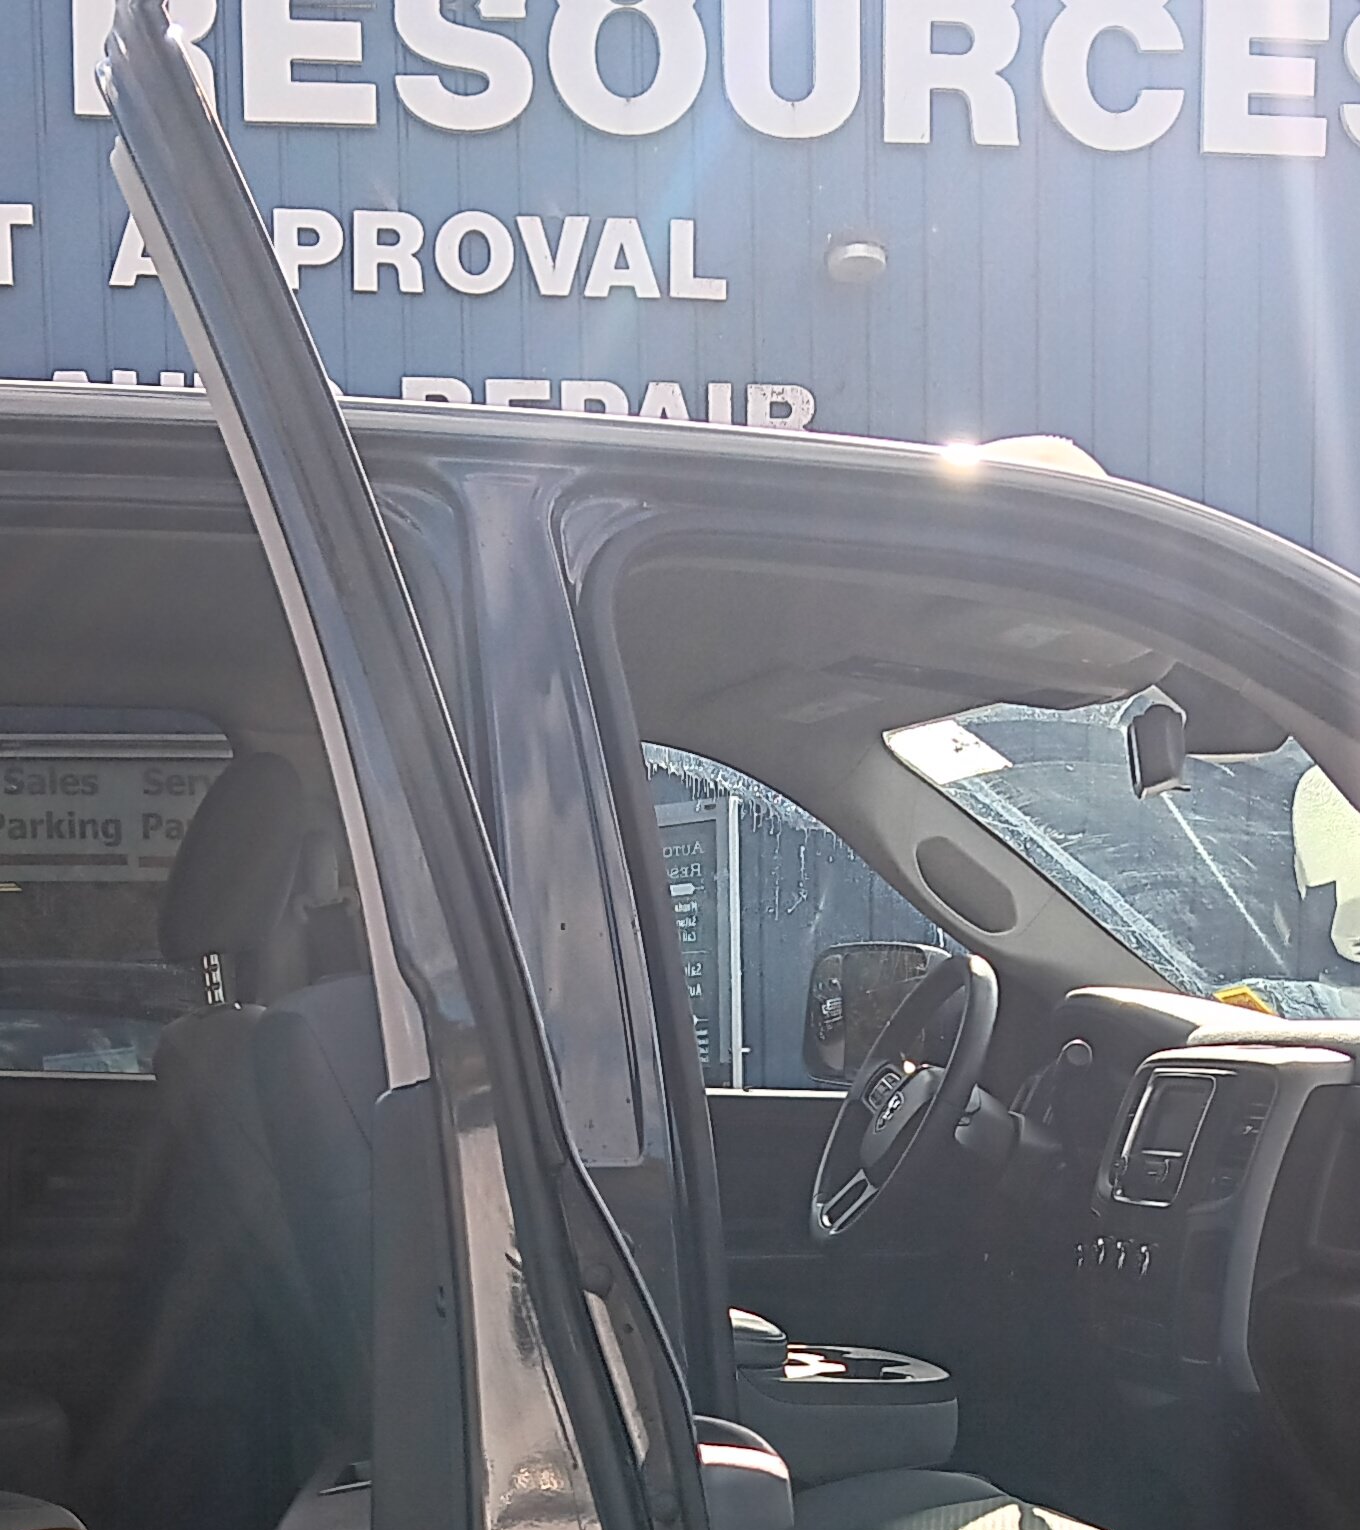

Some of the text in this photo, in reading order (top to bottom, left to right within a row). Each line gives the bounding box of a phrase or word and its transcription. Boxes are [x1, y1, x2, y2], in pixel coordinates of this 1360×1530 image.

[108, 207, 728, 302] APROVAL
[400, 376, 816, 431] AIR
[3, 767, 100, 796] Sales
